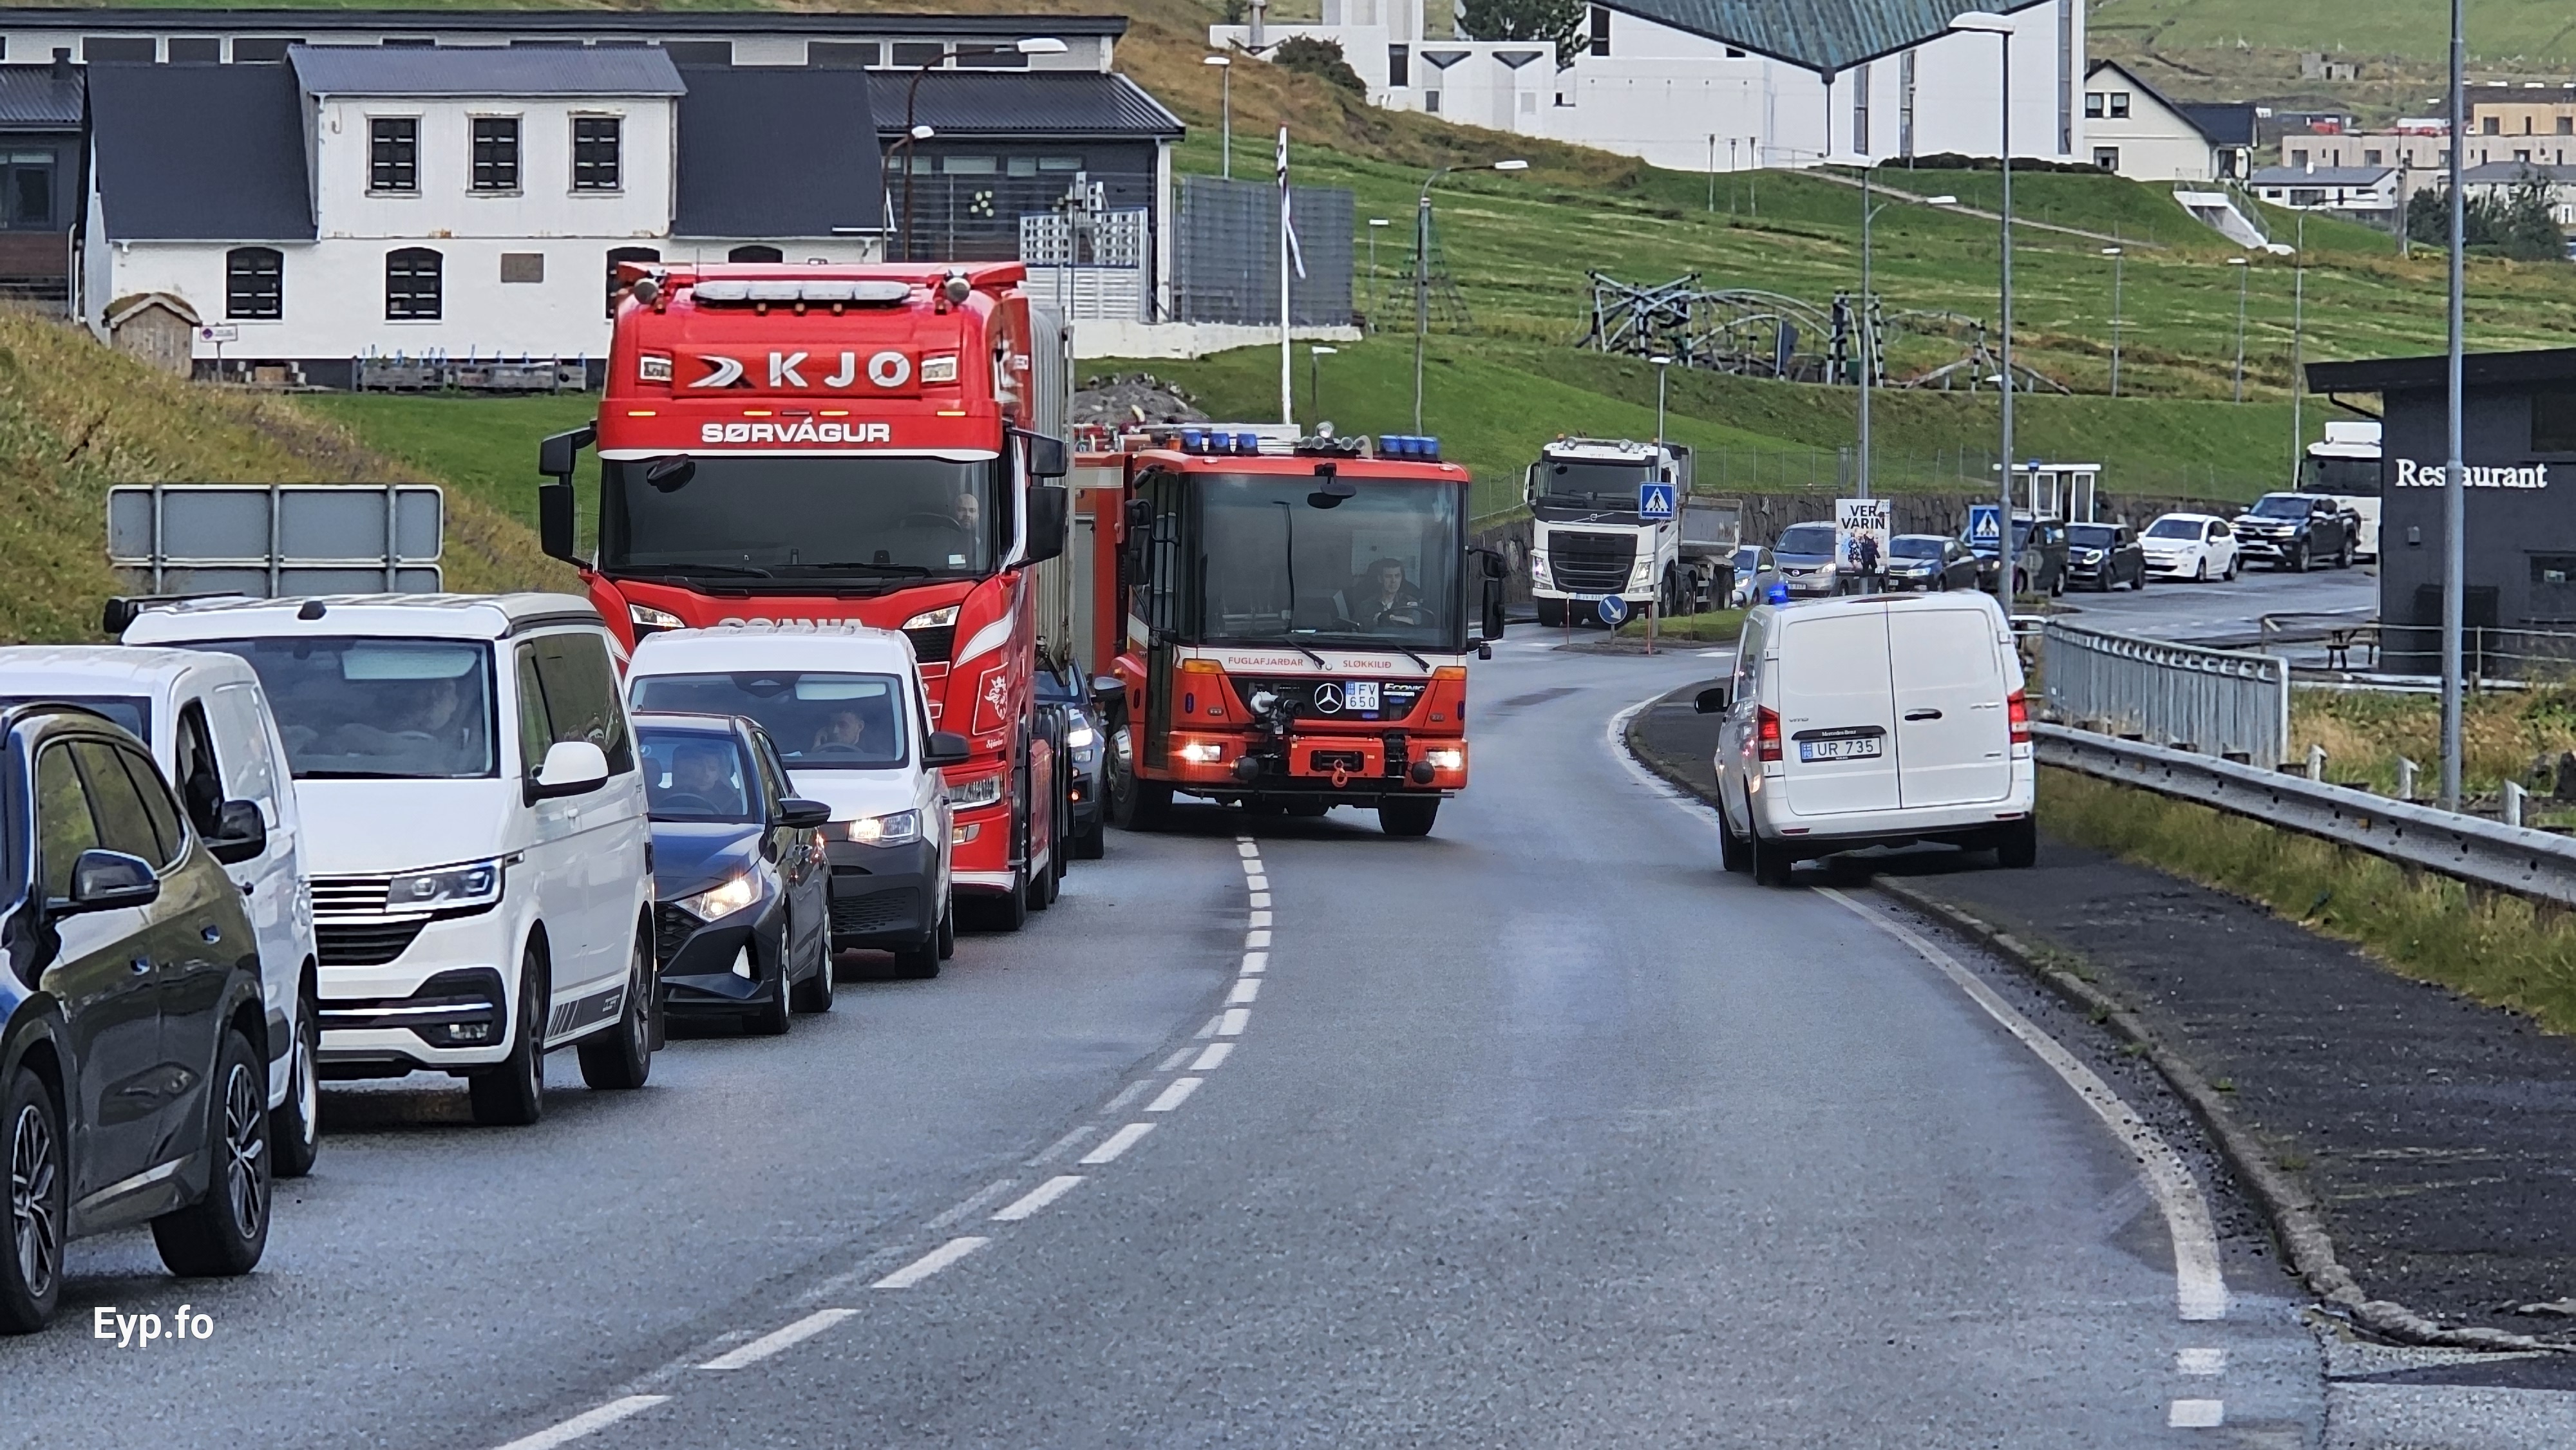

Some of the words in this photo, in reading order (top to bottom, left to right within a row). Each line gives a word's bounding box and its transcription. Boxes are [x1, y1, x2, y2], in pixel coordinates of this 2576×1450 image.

[701, 417, 890, 443] SØRVÁGUR
[2395, 458, 2548, 489] Resaurant
[1850, 505, 1877, 517] VER
[1841, 517, 1885, 529] VARIN
[1228, 656, 1303, 667] FUGLAFJARÐAR
[1343, 660, 1392, 669] SLØKKILIÐ
[1359, 684, 1376, 695] FV
[1350, 696, 1376, 708] 650
[1817, 742, 1839, 756] UR
[1845, 740, 1873, 755] 735
